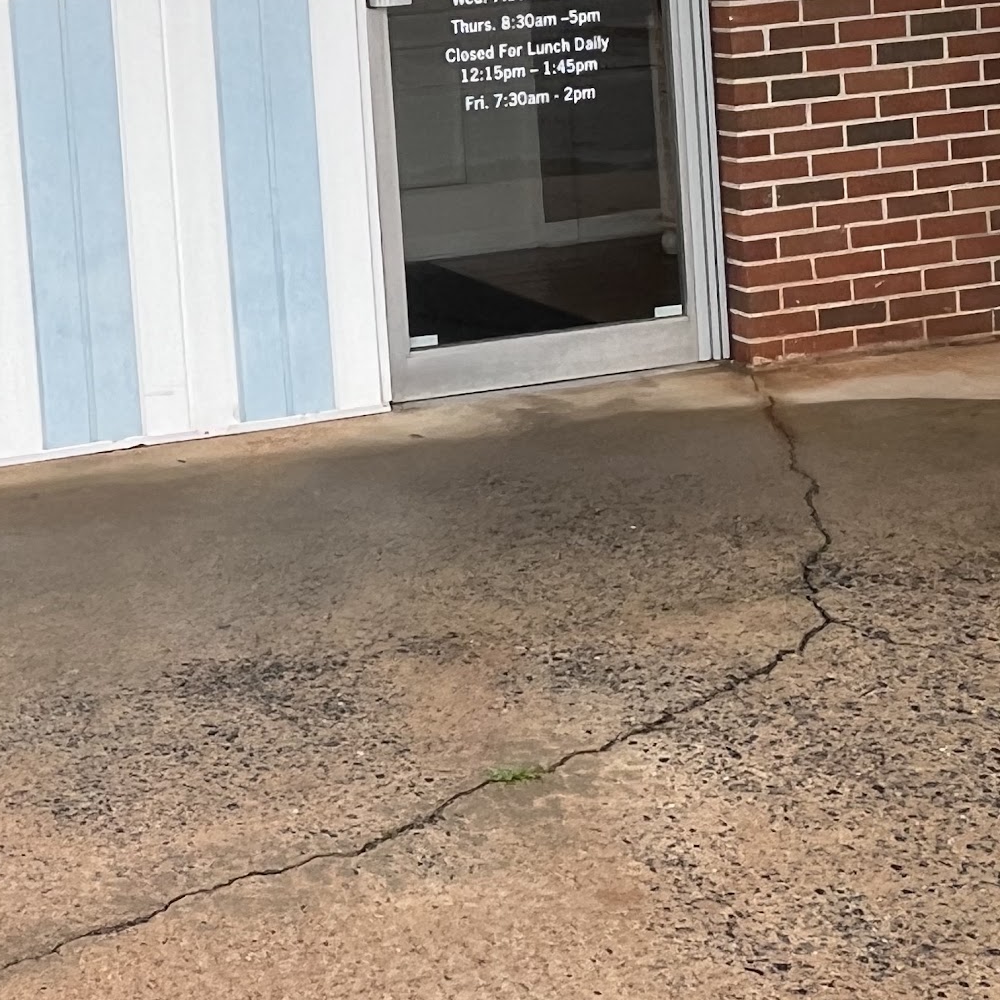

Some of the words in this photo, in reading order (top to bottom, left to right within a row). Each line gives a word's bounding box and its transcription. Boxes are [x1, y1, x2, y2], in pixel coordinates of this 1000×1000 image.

[450, 17, 497, 35] Thurs.
[501, 13, 557, 31] 8:30am
[445, 45, 495, 63] Closed
[499, 42, 523, 58] For
[527, 39, 571, 56] Lunch
[574, 35, 610, 52] Daily
[460, 65, 526, 84] 12:15pm
[543, 58, 598, 77] 1:45pm
[465, 94, 490, 111] Fri.
[493, 90, 550, 108] 7:30am
[563, 86, 596, 102] 2pm
